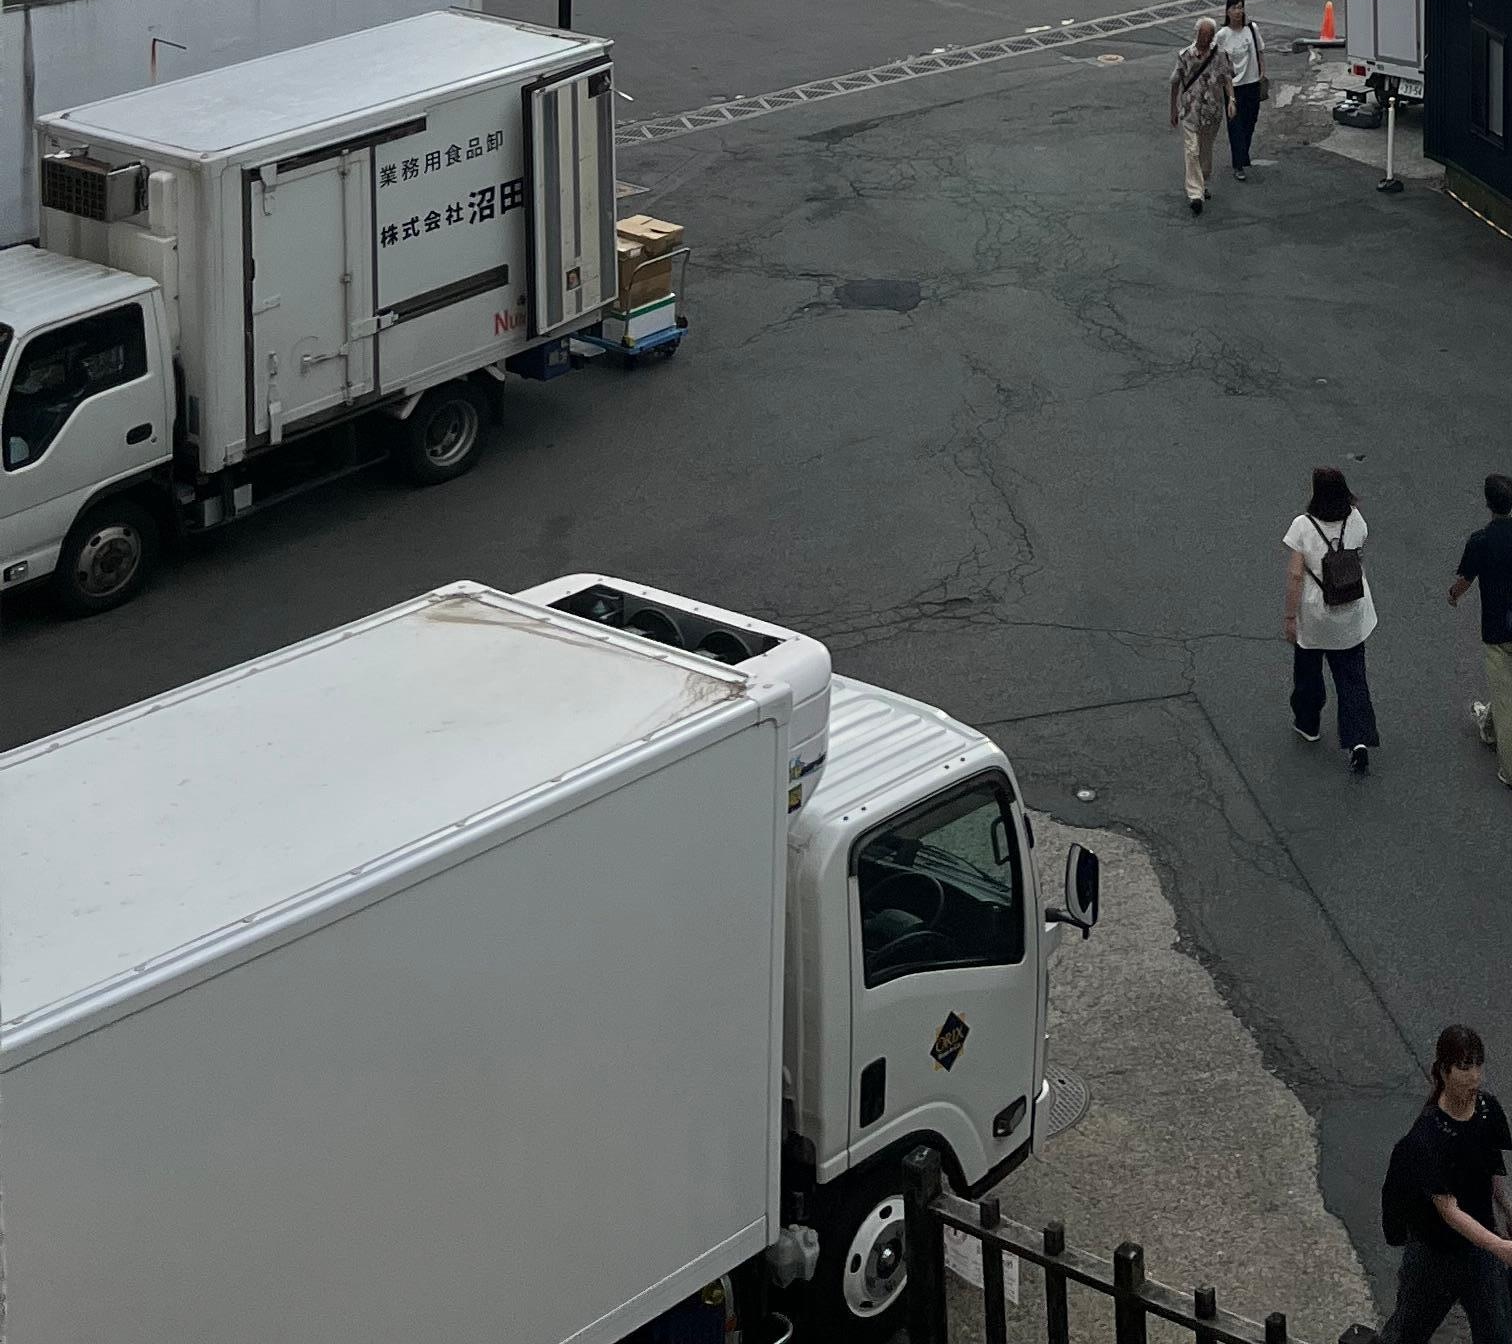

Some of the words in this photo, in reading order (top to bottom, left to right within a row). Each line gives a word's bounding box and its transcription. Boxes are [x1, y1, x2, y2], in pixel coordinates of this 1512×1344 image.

[379, 130, 504, 189] 業務用食品卸
